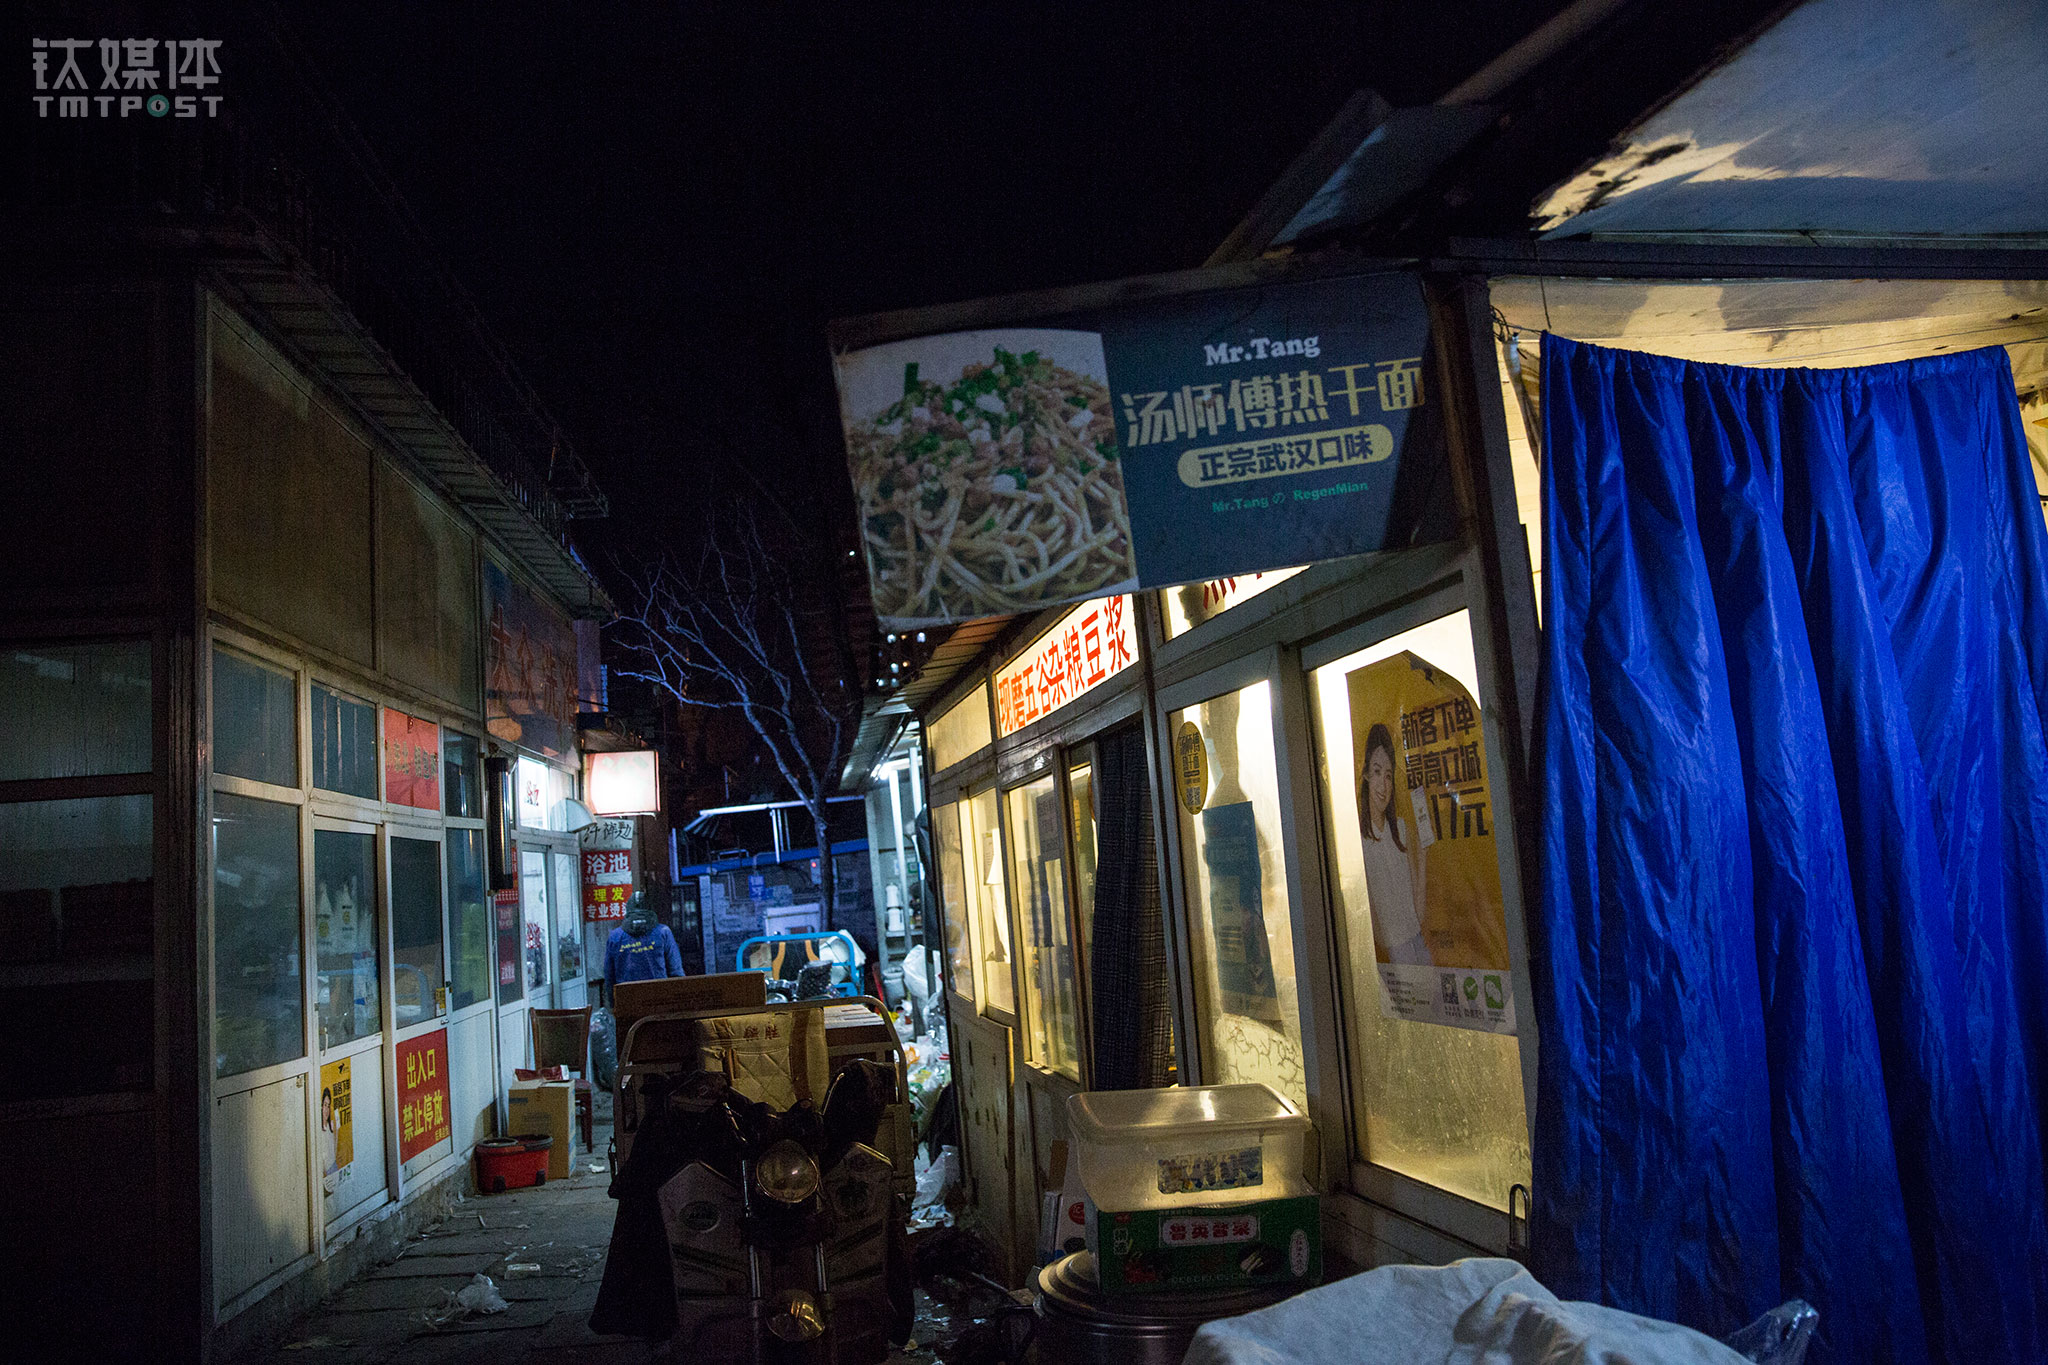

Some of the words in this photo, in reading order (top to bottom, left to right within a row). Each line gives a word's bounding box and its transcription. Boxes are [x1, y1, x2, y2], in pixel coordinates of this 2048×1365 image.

[1203, 335, 1321, 367] Mr.Tang
[1120, 356, 1426, 448] 汤师傅热干面
[1198, 430, 1374, 481] 正宗武汉口味
[998, 595, 1131, 732] 现磨五谷杂粮豆浆
[1400, 694, 1476, 750] 新客下单
[1405, 740, 1482, 790] 最高立减
[586, 852, 629, 875] 浴池
[593, 887, 625, 902] 理发
[406, 1048, 436, 1090] 出入口
[403, 1088, 444, 1143] 禁止停放
